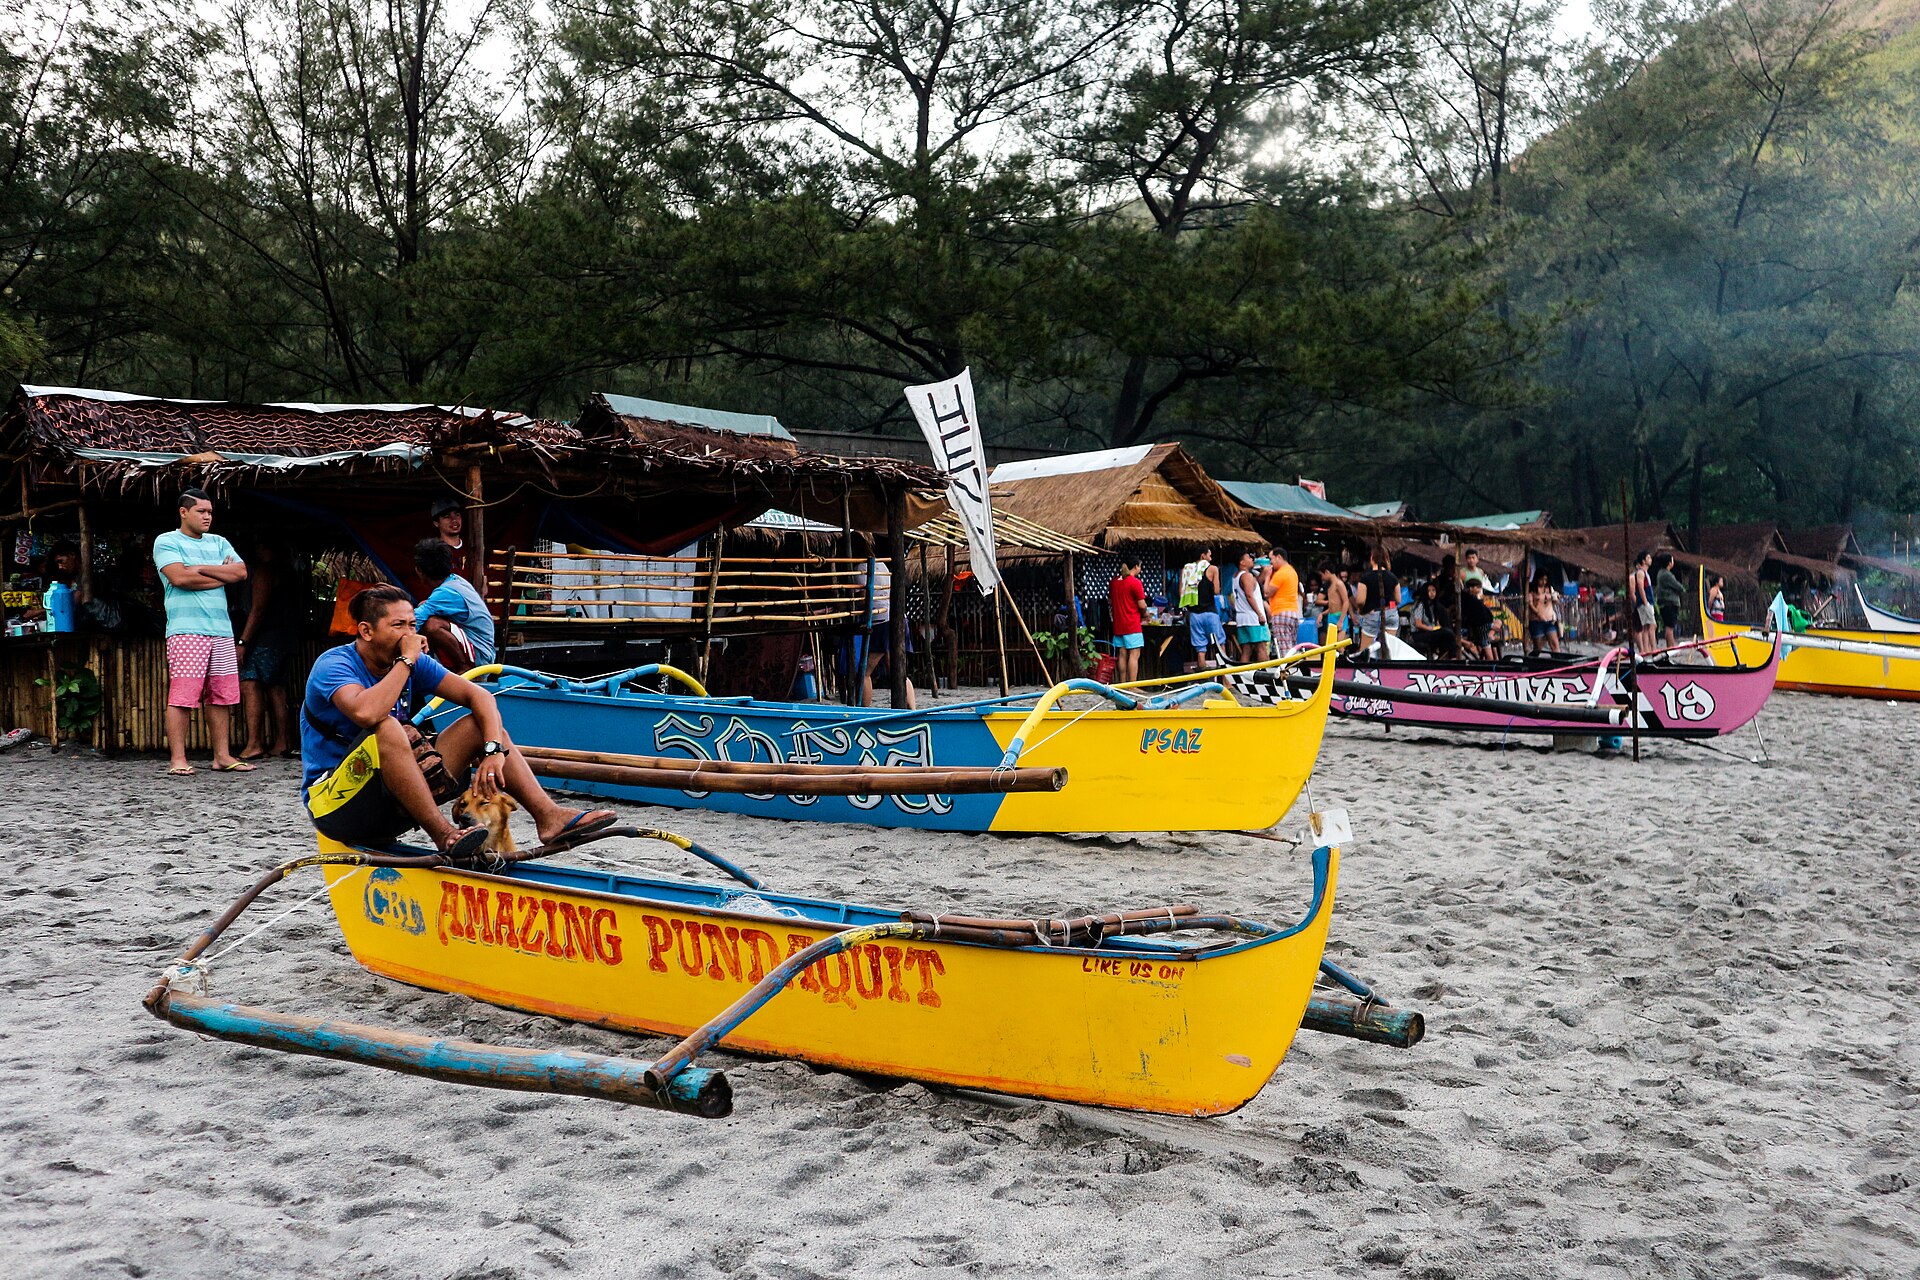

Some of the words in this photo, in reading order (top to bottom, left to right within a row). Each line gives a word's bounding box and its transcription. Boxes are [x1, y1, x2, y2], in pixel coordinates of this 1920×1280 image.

[1344, 695, 1370, 711] Hello
[1659, 680, 1715, 721] 19
[1140, 727, 1204, 754] PSAZ
[436, 880, 624, 968] AMAZING
[1082, 957, 1122, 976] LIKE
[1130, 961, 1153, 978] US
[1158, 965, 1186, 981] ON
